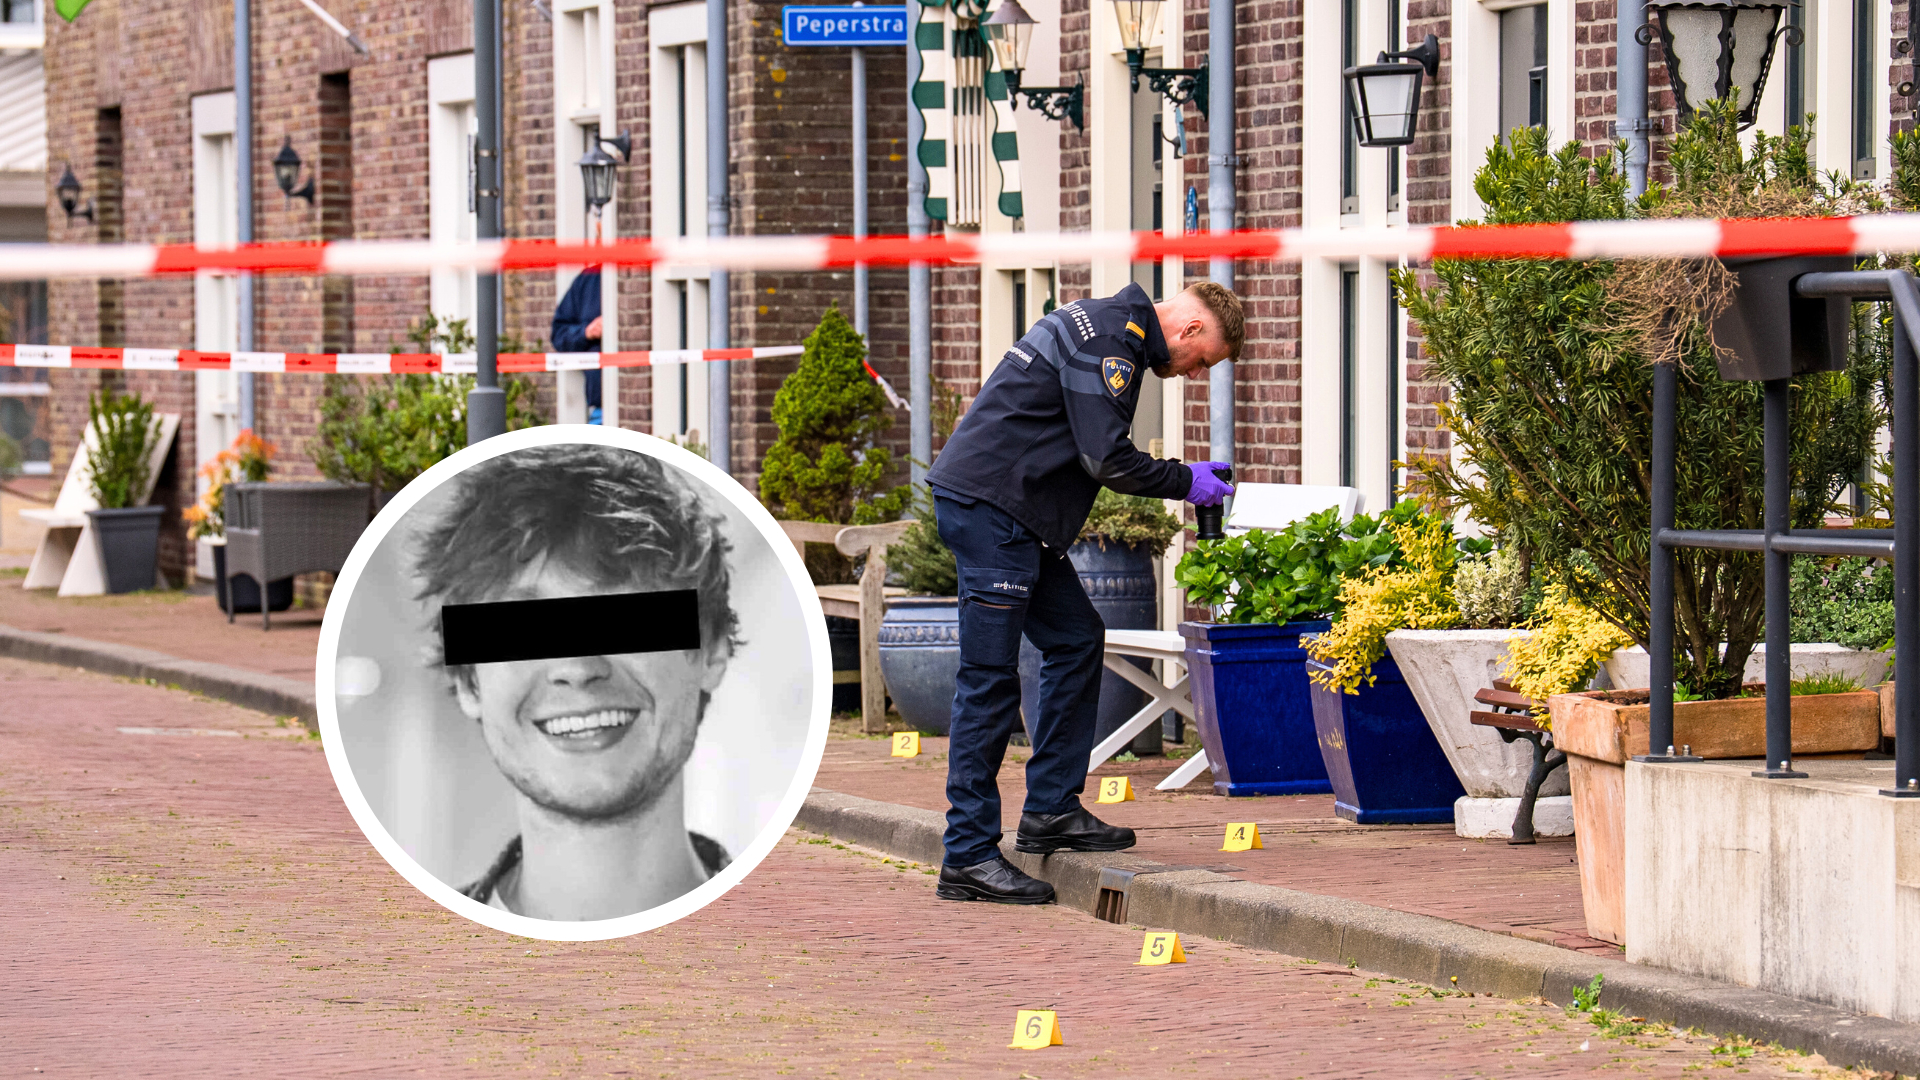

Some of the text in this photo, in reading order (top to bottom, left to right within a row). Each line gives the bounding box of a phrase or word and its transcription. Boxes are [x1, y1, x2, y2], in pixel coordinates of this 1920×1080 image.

[796, 14, 905, 38] Peperstra
[1106, 361, 1131, 373] POLITIE
[900, 735, 911, 750] 2
[1107, 780, 1119, 797] 3
[1232, 826, 1246, 841] 4
[1150, 936, 1167, 957] 5
[1025, 1015, 1043, 1039] 6
